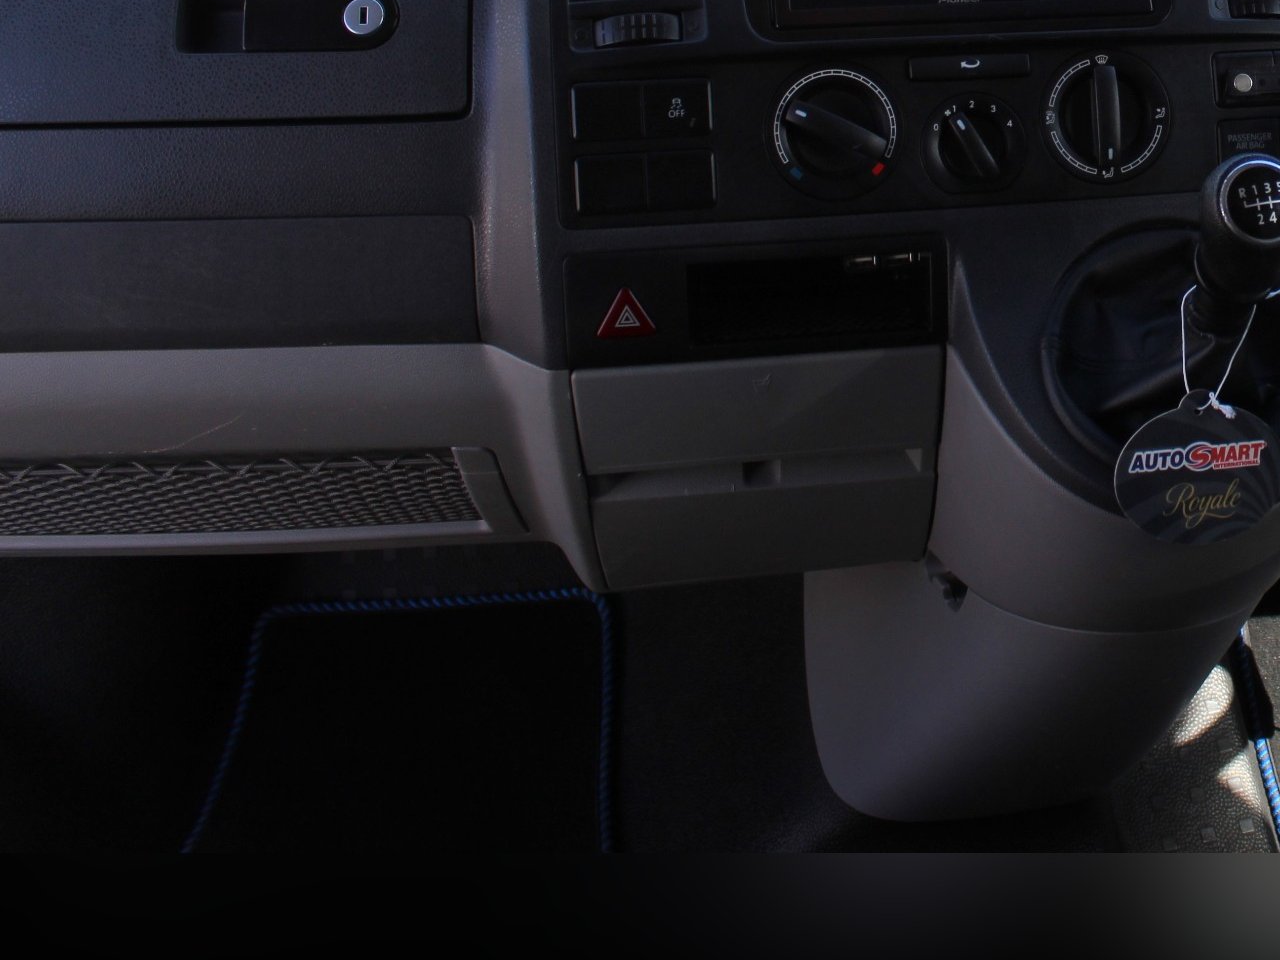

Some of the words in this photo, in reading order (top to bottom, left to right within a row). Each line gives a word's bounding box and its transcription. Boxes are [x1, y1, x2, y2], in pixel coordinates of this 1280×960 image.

[969, 100, 975, 108] 2
[990, 104, 996, 112] 3
[668, 109, 685, 118] OFF
[933, 123, 939, 131] 0
[1007, 119, 1013, 127] 4
[1227, 132, 1273, 142] PASSENGER
[1249, 140, 1265, 149] BAG
[1238, 187, 1246, 199] R
[1252, 184, 1258, 195] 1
[1264, 182, 1272, 194] 3
[1258, 213, 1265, 225] 2
[1269, 211, 1278, 224] 4
[1129, 441, 1265, 474] AUTOSMART
[1163, 478, 1242, 529] Royale
